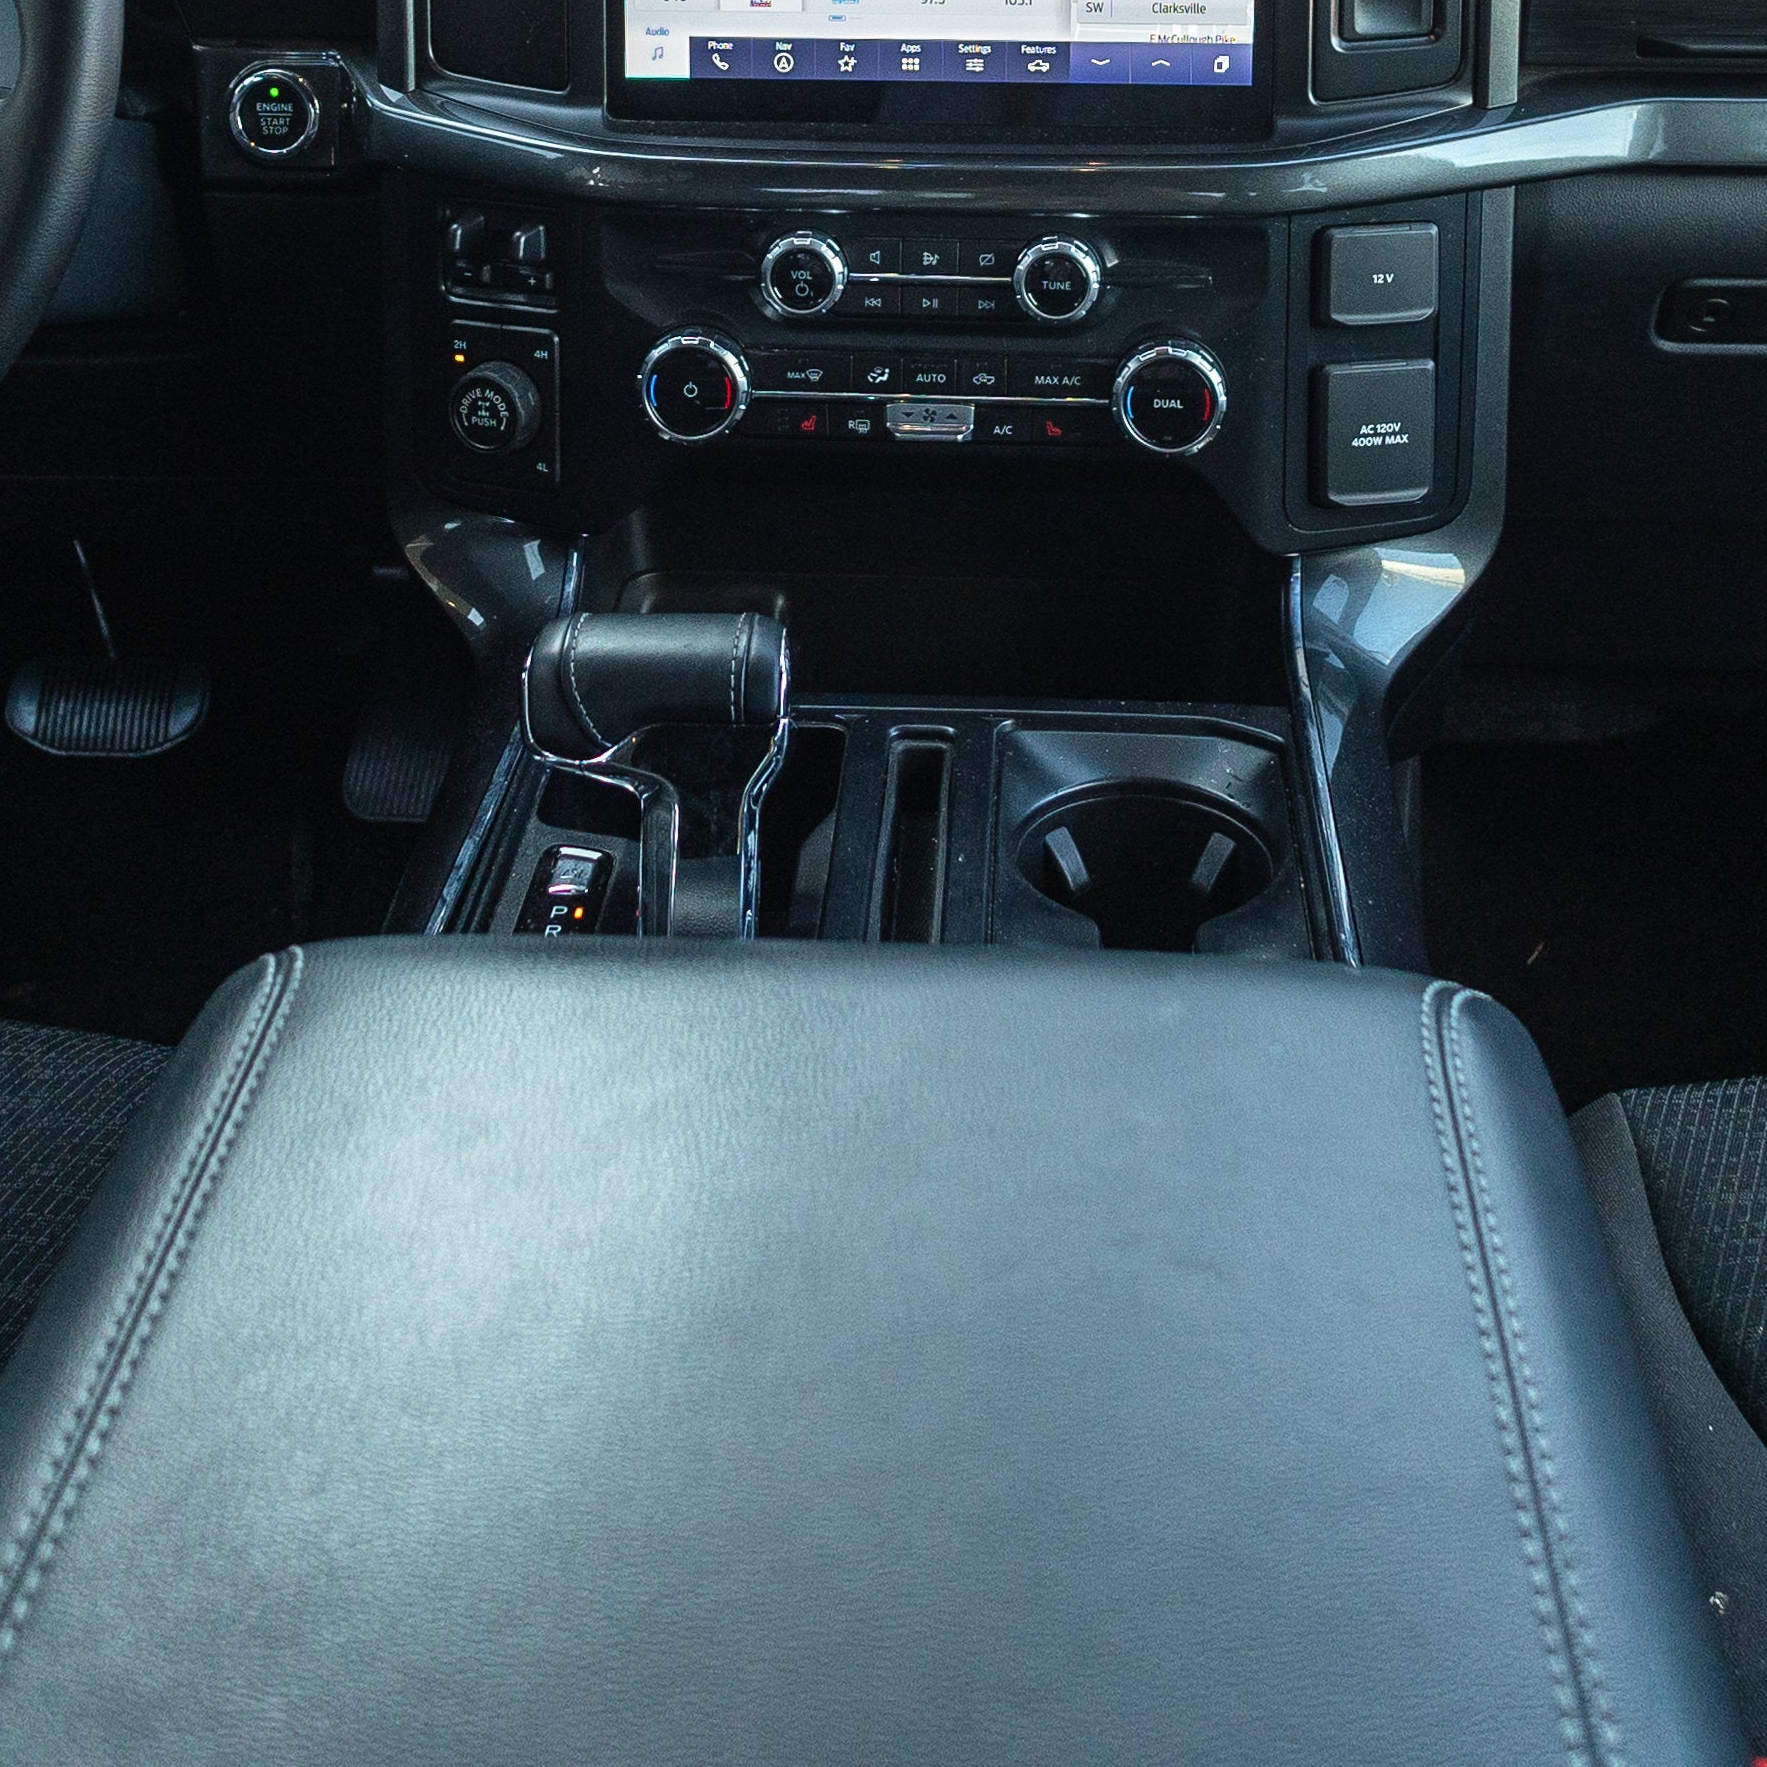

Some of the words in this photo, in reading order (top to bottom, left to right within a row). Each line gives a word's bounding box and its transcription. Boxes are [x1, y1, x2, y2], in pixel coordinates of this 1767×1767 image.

[1085, 1, 1105, 14] SW
[1151, 2, 1207, 15] Clarksville
[645, 27, 670, 37] Audio
[708, 40, 733, 50] Phone
[775, 41, 792, 51] Nav
[839, 42, 855, 52] Fav
[900, 43, 921, 54] Apps
[958, 44, 992, 55] Settings
[1021, 45, 1057, 55] Features
[256, 102, 293, 113] ENGINE
[260, 117, 291, 126] START
[262, 126, 289, 135] STOP
[790, 270, 812, 281] VOL
[1372, 274, 1385, 283] 12
[1385, 273, 1394, 283] V
[1042, 280, 1072, 291] TUNE
[453, 339, 467, 350] 2H
[533, 349, 548, 360] 4H
[787, 370, 806, 380] MAX
[916, 372, 946, 383] AUTO
[1034, 375, 1059, 385] MAX
[1061, 375, 1082, 386] A/C
[459, 387, 483, 414] DRIVE
[484, 388, 509, 418] MODE
[1153, 398, 1184, 409] DUAL
[471, 416, 497, 427] PUSH
[993, 424, 1013, 435] A/C
[1359, 424, 1375, 434] AC
[1376, 422, 1401, 434] 120V
[1351, 436, 1384, 447] 400W
[1385, 434, 1409, 445] MAX
[536, 461, 548, 472] 4L
[550, 905, 568, 919] P
[544, 924, 562, 938] R
